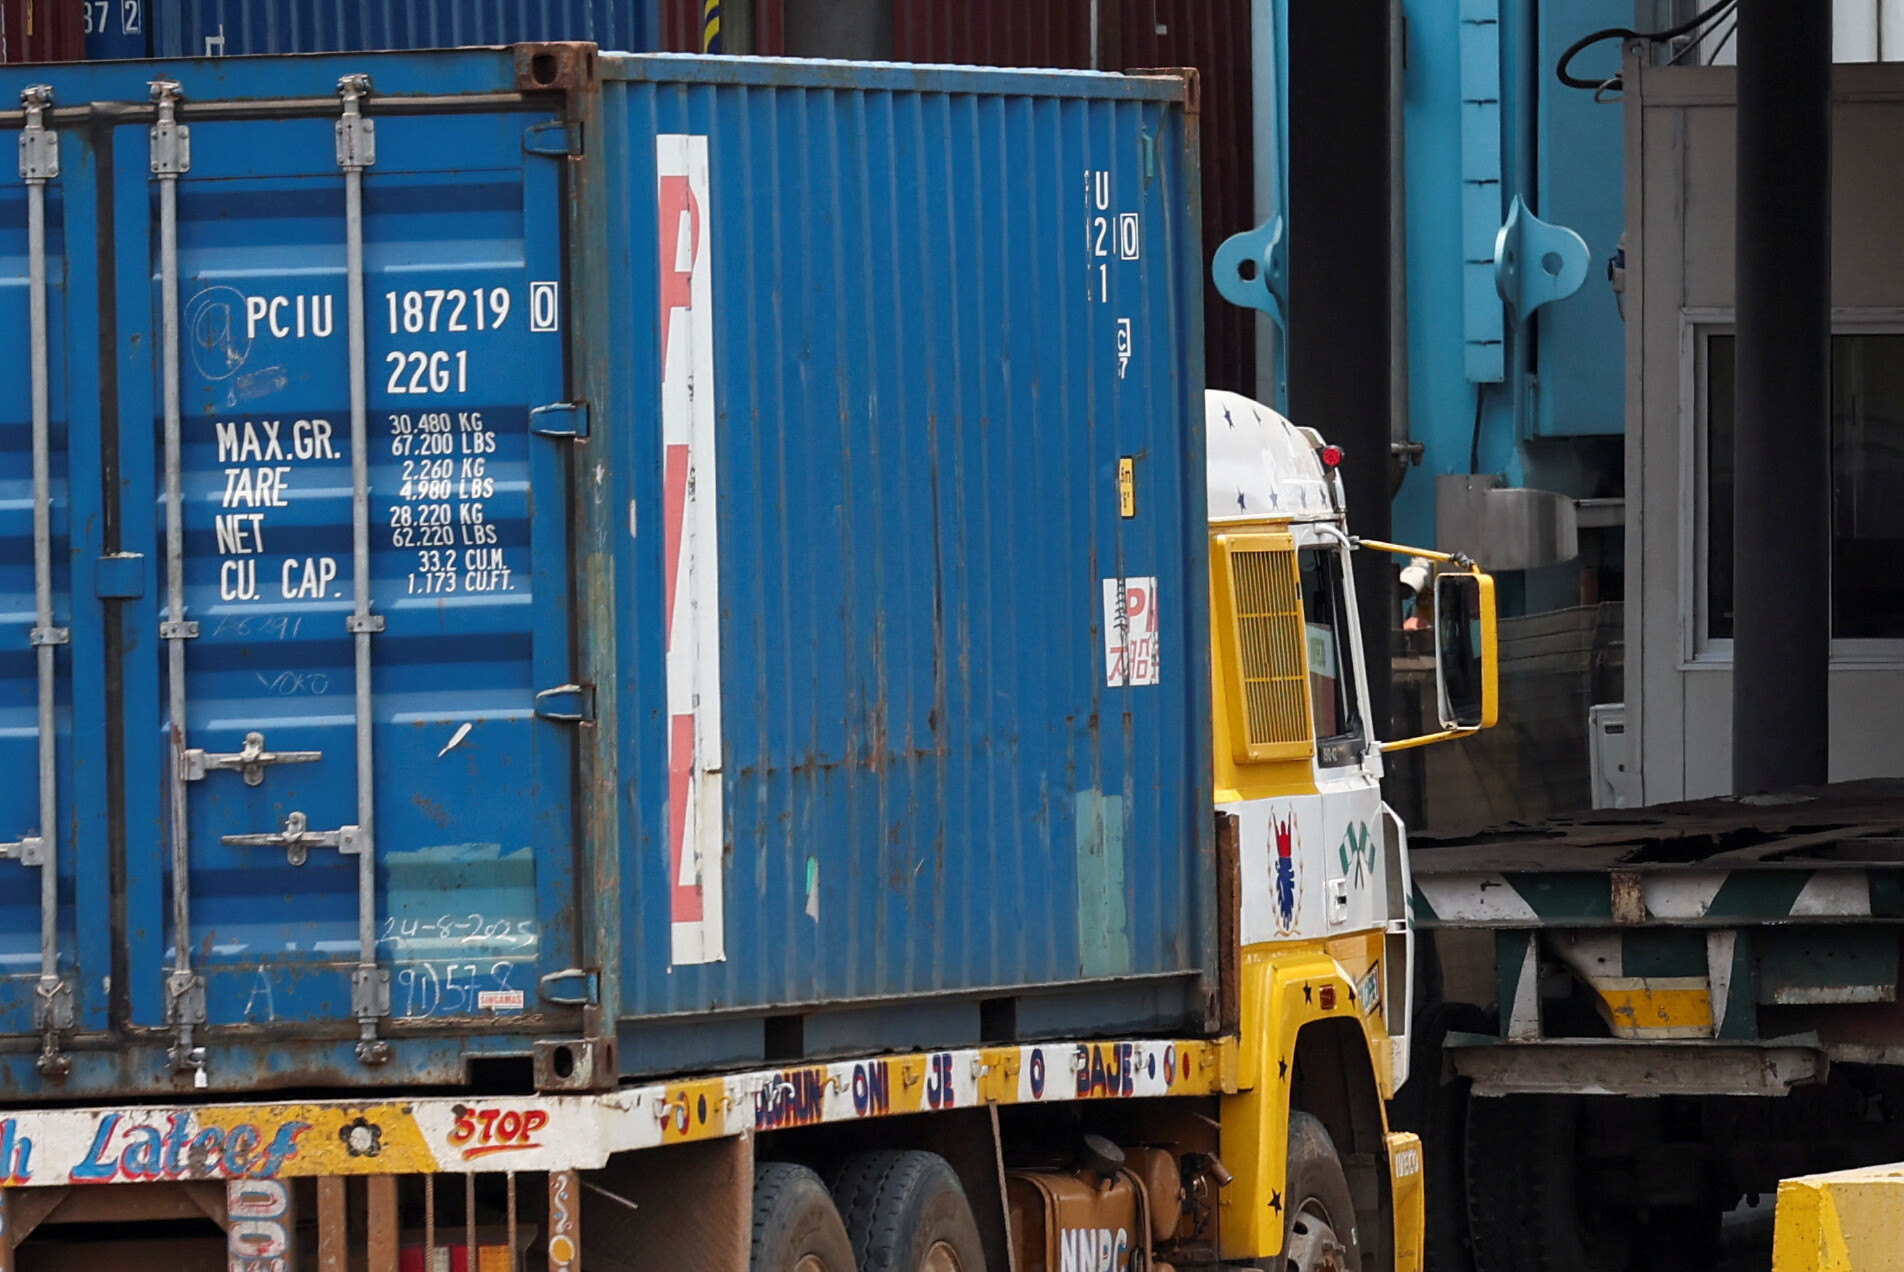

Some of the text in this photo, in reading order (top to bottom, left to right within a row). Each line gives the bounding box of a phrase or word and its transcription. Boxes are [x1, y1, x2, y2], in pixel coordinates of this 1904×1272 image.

[247, 294, 333, 339] PCIU
[386, 287, 511, 335] 187219
[532, 283, 557, 331] 0
[386, 350, 468, 395] 22G1
[215, 412, 483, 463] MAX.GR. 30.480 KG
[391, 431, 496, 456] 67.200 LBS
[222, 457, 486, 508] TARE 2.260 KG
[399, 477, 495, 501] 4.980 LBS
[215, 502, 483, 555] NET 28.220 KG
[392, 524, 498, 547] 62.220 LBS
[220, 548, 508, 601] CU. CAP. 33.2 CU.M.
[408, 569, 515, 595] 1.173 CU.FT.
[852, 1060, 890, 1117] ONI
[927, 1053, 955, 1111] JE
[1029, 1048, 1046, 1101] O
[447, 1107, 550, 1148] STOP
